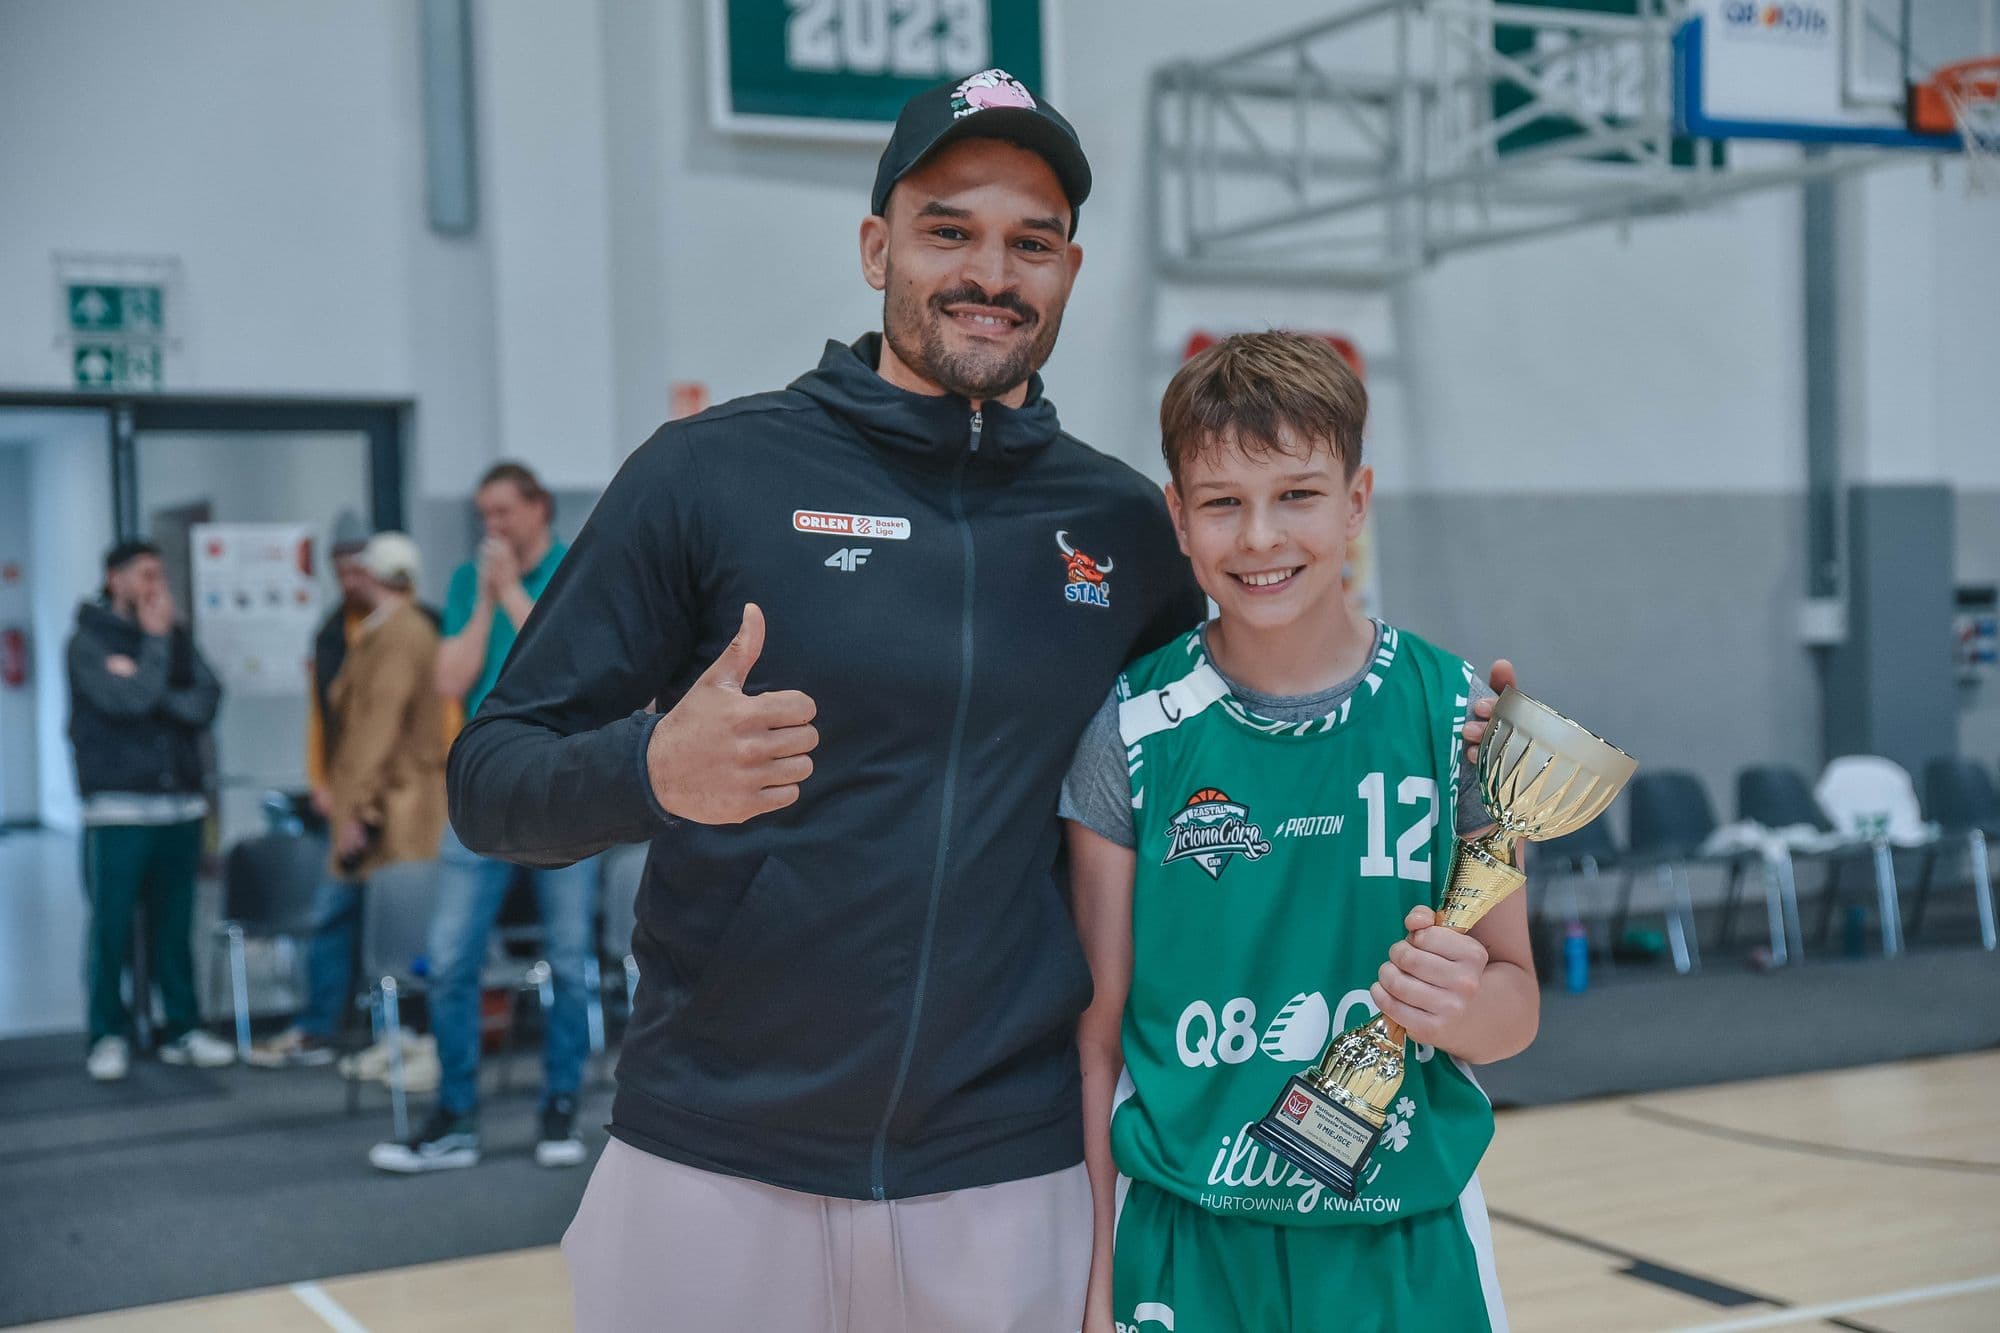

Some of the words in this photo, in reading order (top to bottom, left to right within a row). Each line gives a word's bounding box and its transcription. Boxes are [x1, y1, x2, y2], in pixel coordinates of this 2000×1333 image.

[799, 515, 849, 530] ORLEN
[876, 519, 904, 528] Basket
[876, 528, 893, 536] Liga
[824, 547, 873, 572] 4F
[1065, 581, 1110, 608] STAL
[1192, 805, 1227, 818] ZASTAL
[1284, 815, 1345, 838] PROTON
[1358, 772, 1440, 883] 12
[1176, 997, 1258, 1068] Q8
[1316, 1122, 1323, 1130] II
[1322, 1126, 1352, 1148] MIEJSCE
[1200, 1193, 1295, 1211] HURTOWNIA
[1323, 1194, 1401, 1213] KWIATÓW
